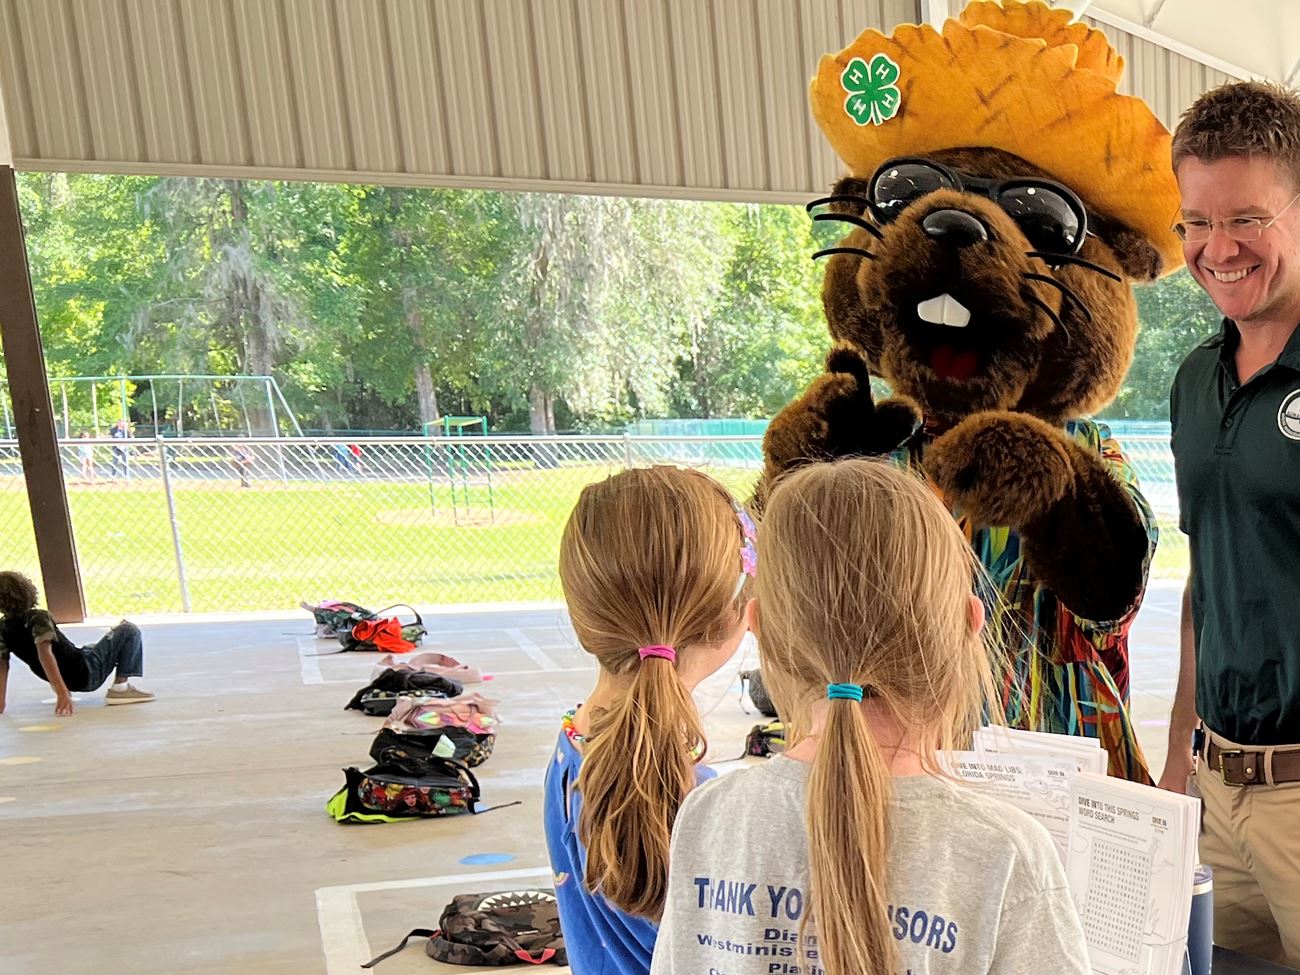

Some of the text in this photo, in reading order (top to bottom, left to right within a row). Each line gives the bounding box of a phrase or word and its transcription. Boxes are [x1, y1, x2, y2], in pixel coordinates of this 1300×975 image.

[849, 69, 863, 84] H
[876, 64, 890, 79] H
[853, 99, 866, 115] H
[882, 94, 894, 108] H
[1078, 796, 1139, 821] DIVE INTO THIS SPRINGS
[1079, 806, 1094, 818] WORD
[1095, 811, 1115, 824] SEARCH
[767, 885, 802, 920] YO
